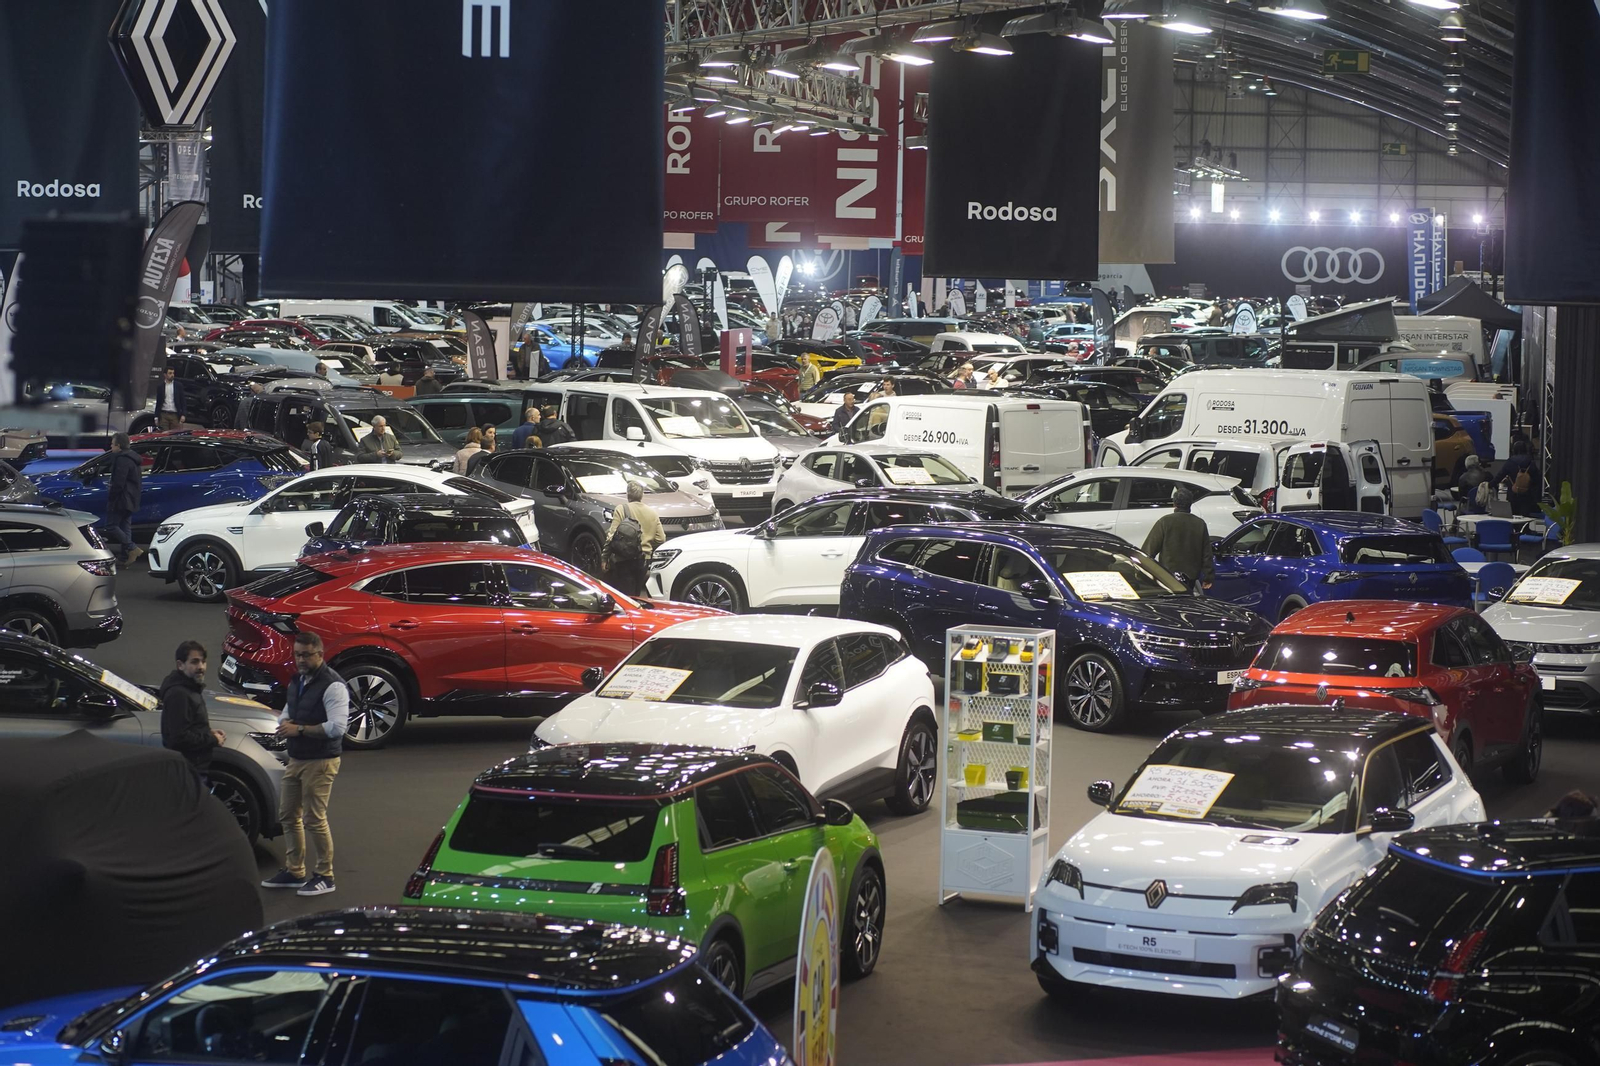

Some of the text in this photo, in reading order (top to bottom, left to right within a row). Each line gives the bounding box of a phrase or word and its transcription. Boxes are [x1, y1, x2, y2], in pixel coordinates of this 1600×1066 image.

[1121, 56, 1128, 74] LO
[177, 145, 198, 156] OPEL
[17, 179, 101, 198] Rodosa
[724, 196, 809, 206] GRUPO ROFER
[680, 211, 714, 220] ROFER
[967, 201, 1057, 222] Rodosa
[904, 235, 924, 243] GRU
[142, 237, 175, 290] AUTESA
[1212, 399, 1235, 407] RODOSA
[1218, 425, 1242, 434] DESDE
[1244, 419, 1288, 435] 31.300
[904, 433, 921, 442] DESDE
[922, 429, 956, 444] 26.900
[507, 880, 558, 888] RENAULT
[1142, 936, 1157, 946] R5
